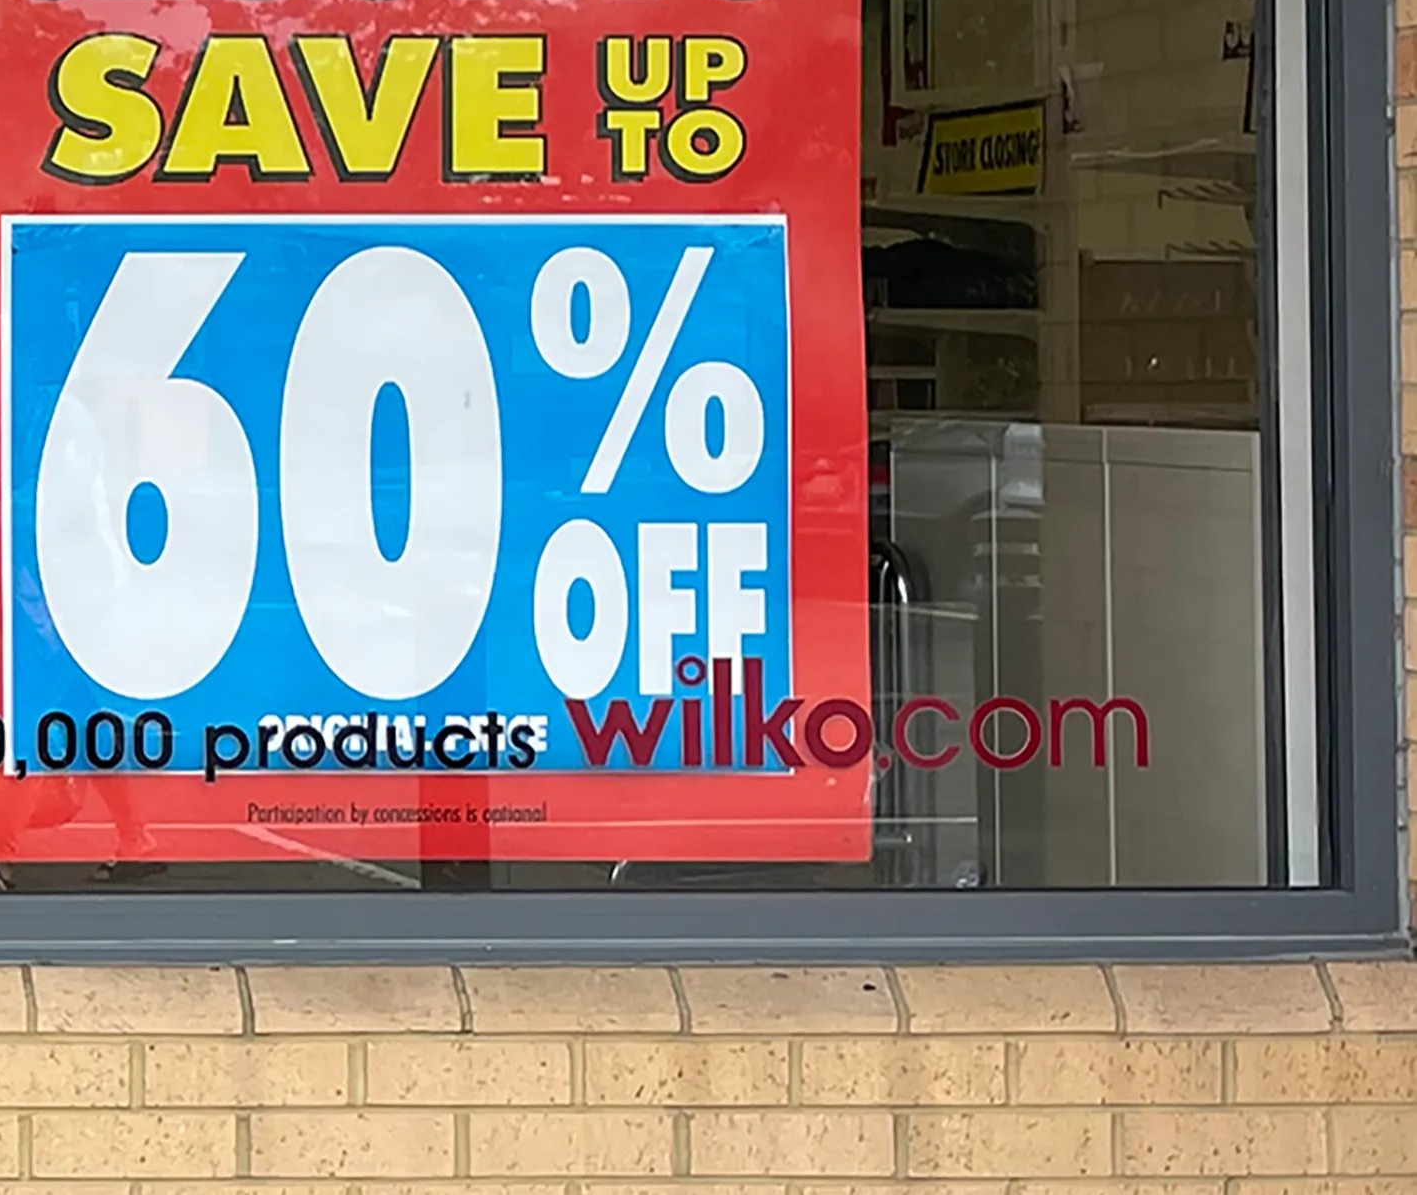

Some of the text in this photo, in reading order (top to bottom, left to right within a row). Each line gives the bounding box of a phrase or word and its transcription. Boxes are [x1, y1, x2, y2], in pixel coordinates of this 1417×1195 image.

[44, 31, 549, 184] SAVE
[599, 35, 748, 110] UP
[599, 108, 748, 182] TO
[532, 517, 769, 703] OFF
[204, 708, 539, 782] products
[565, 656, 1150, 771] wilko.com
[247, 802, 548, 825] Participation by concessions is optional
